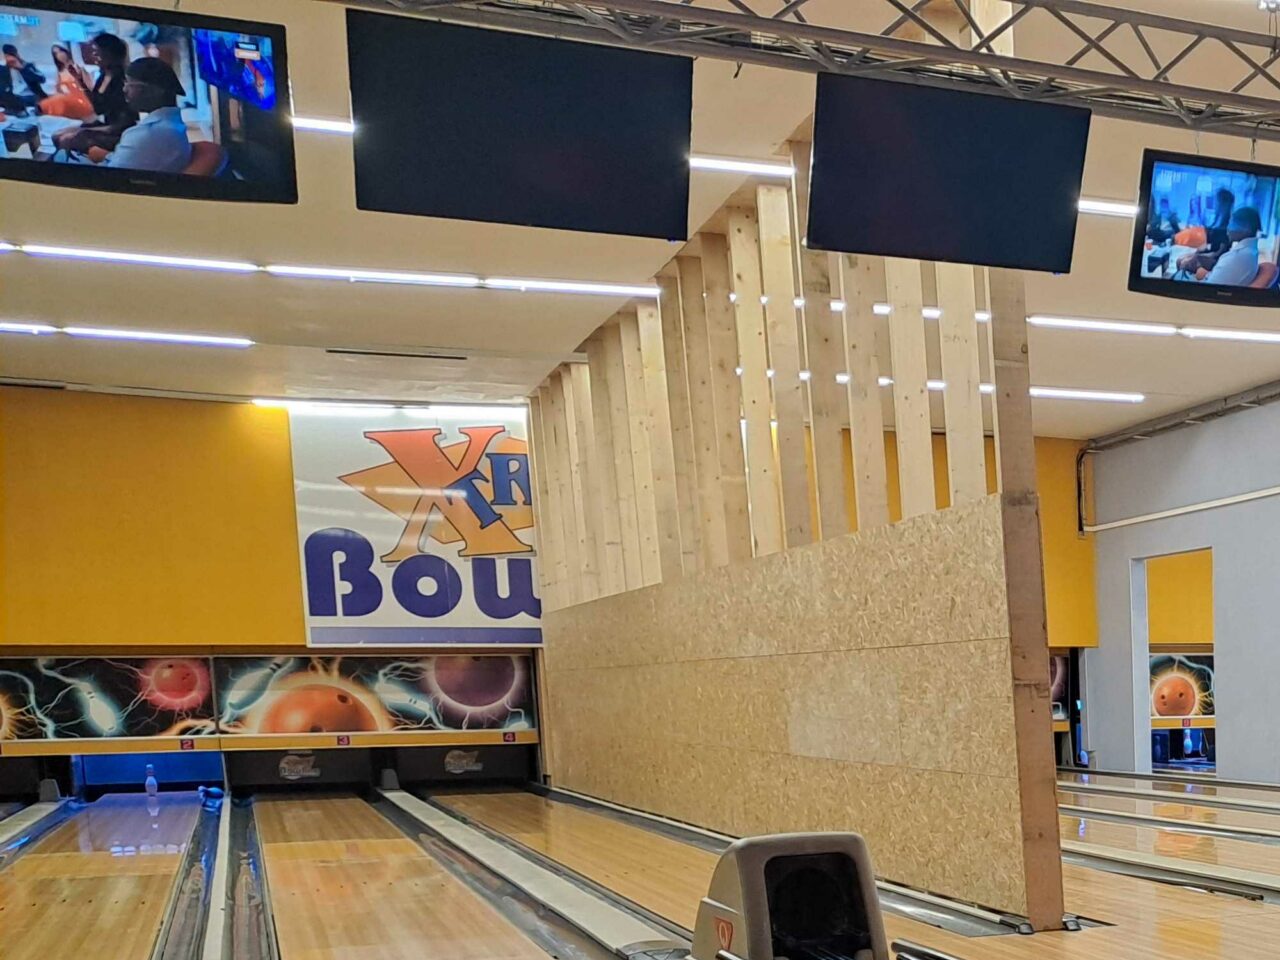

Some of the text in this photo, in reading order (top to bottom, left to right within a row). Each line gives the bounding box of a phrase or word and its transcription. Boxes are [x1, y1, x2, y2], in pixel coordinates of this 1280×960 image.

[338, 735, 349, 745] 3
[504, 732, 514, 742] 4
[182, 740, 193, 749] 2
